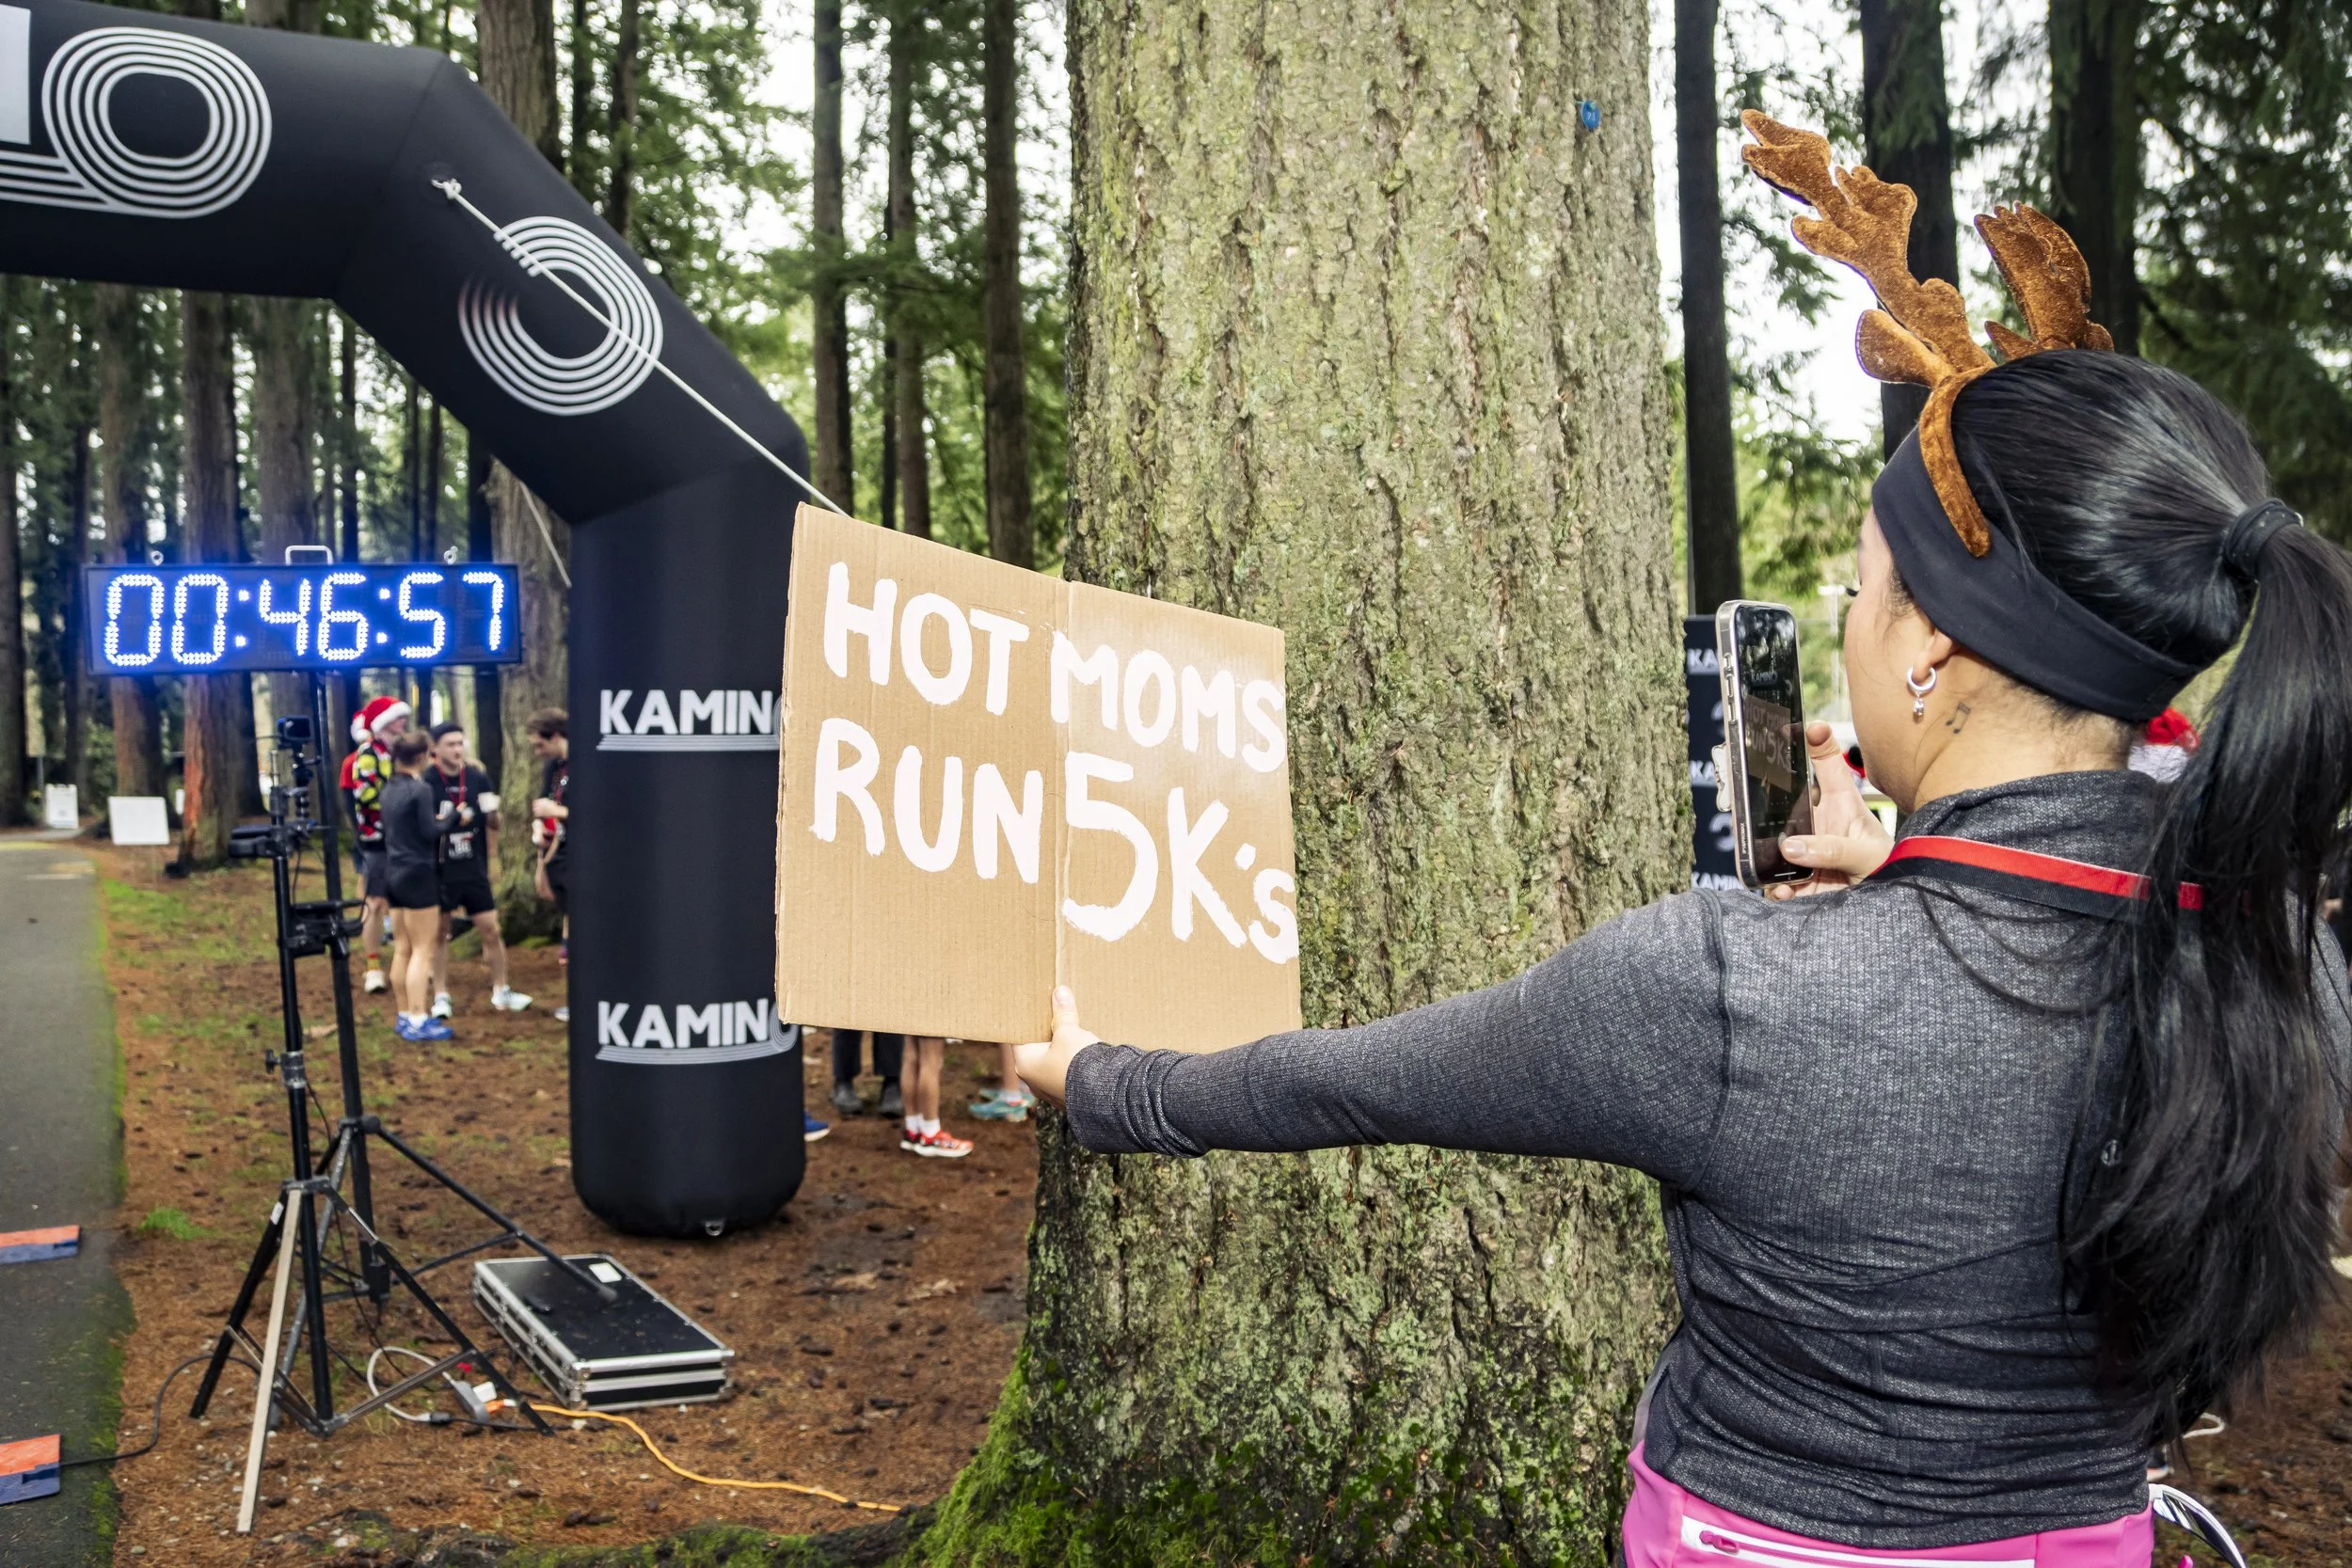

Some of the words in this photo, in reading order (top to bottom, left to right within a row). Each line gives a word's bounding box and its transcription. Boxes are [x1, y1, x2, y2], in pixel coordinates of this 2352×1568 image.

[104, 571, 504, 666] 00:46:57
[823, 562, 1030, 716] HOT
[1049, 628, 1286, 773] MOMS
[599, 689, 783, 735] KAMIN
[809, 718, 1043, 885] RUN
[1061, 751, 1299, 965] 5K's
